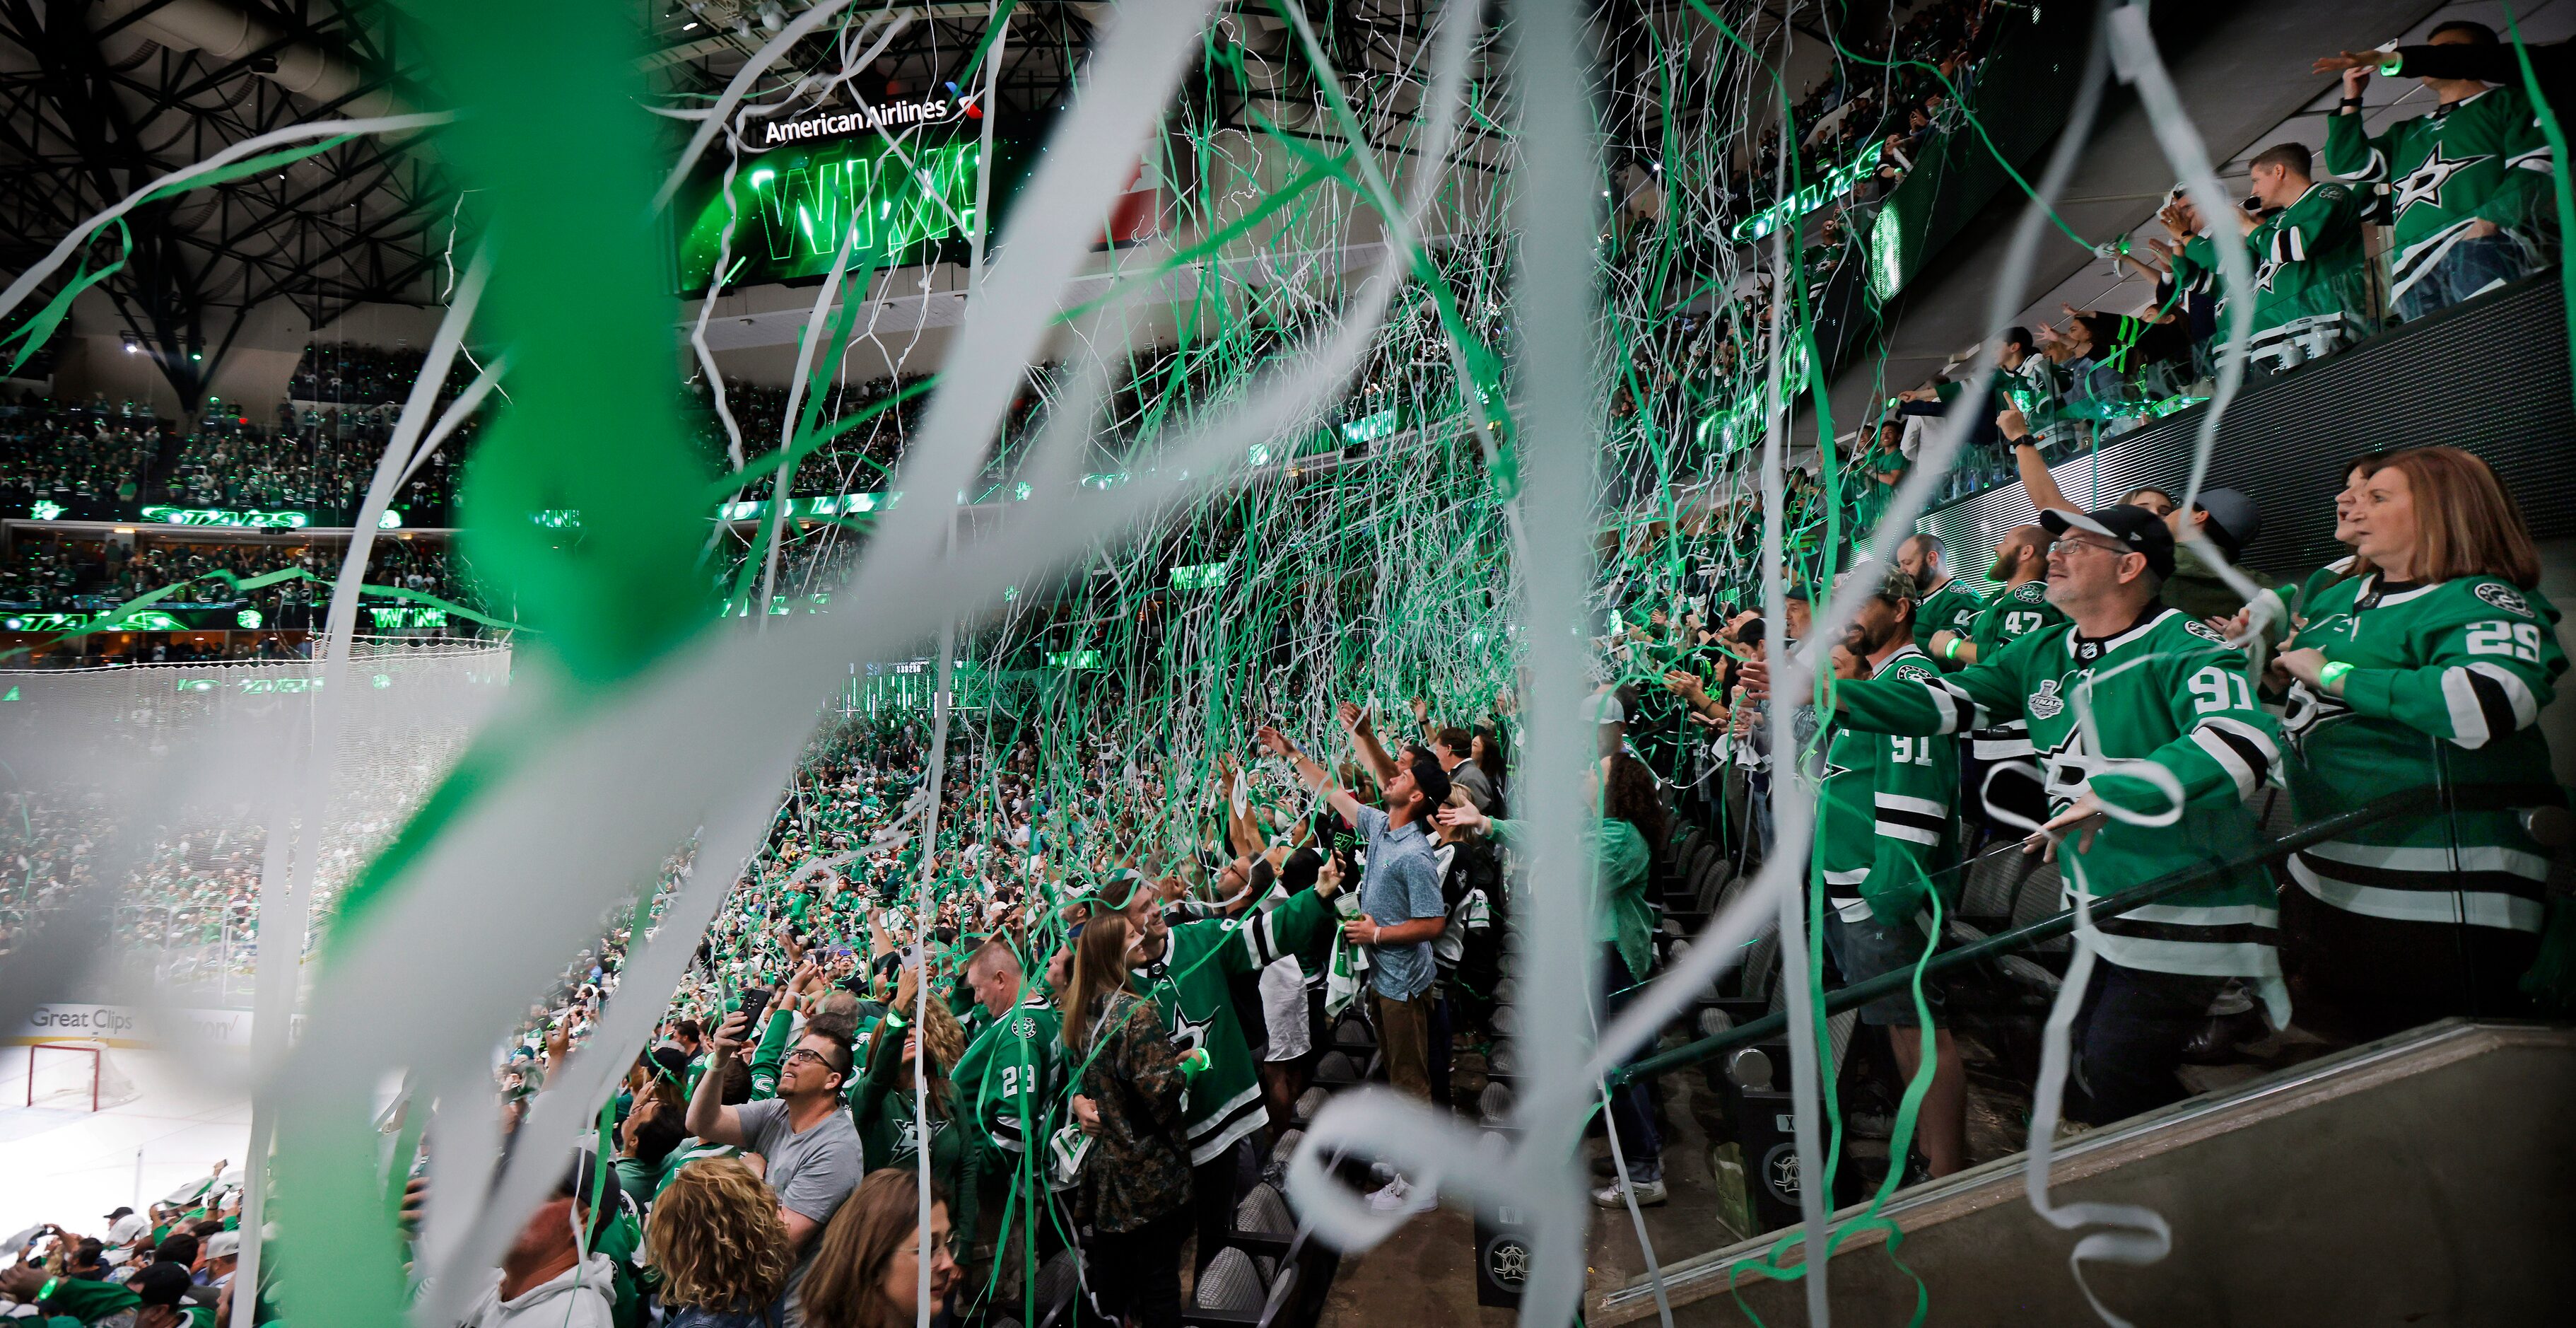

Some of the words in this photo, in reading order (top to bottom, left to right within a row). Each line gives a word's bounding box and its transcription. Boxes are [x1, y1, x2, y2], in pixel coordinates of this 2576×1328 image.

[765, 111, 864, 144] American
[866, 98, 948, 129] Airlines
[141, 506, 305, 528] STARS
[2005, 611, 2042, 635] 47
[2466, 620, 2541, 663] 29
[2187, 665, 2254, 715] 91
[1890, 735, 1933, 767] 91
[30, 1007, 88, 1027] Great
[93, 1008, 133, 1031] Clips
[1506, 1207, 1516, 1223] W
